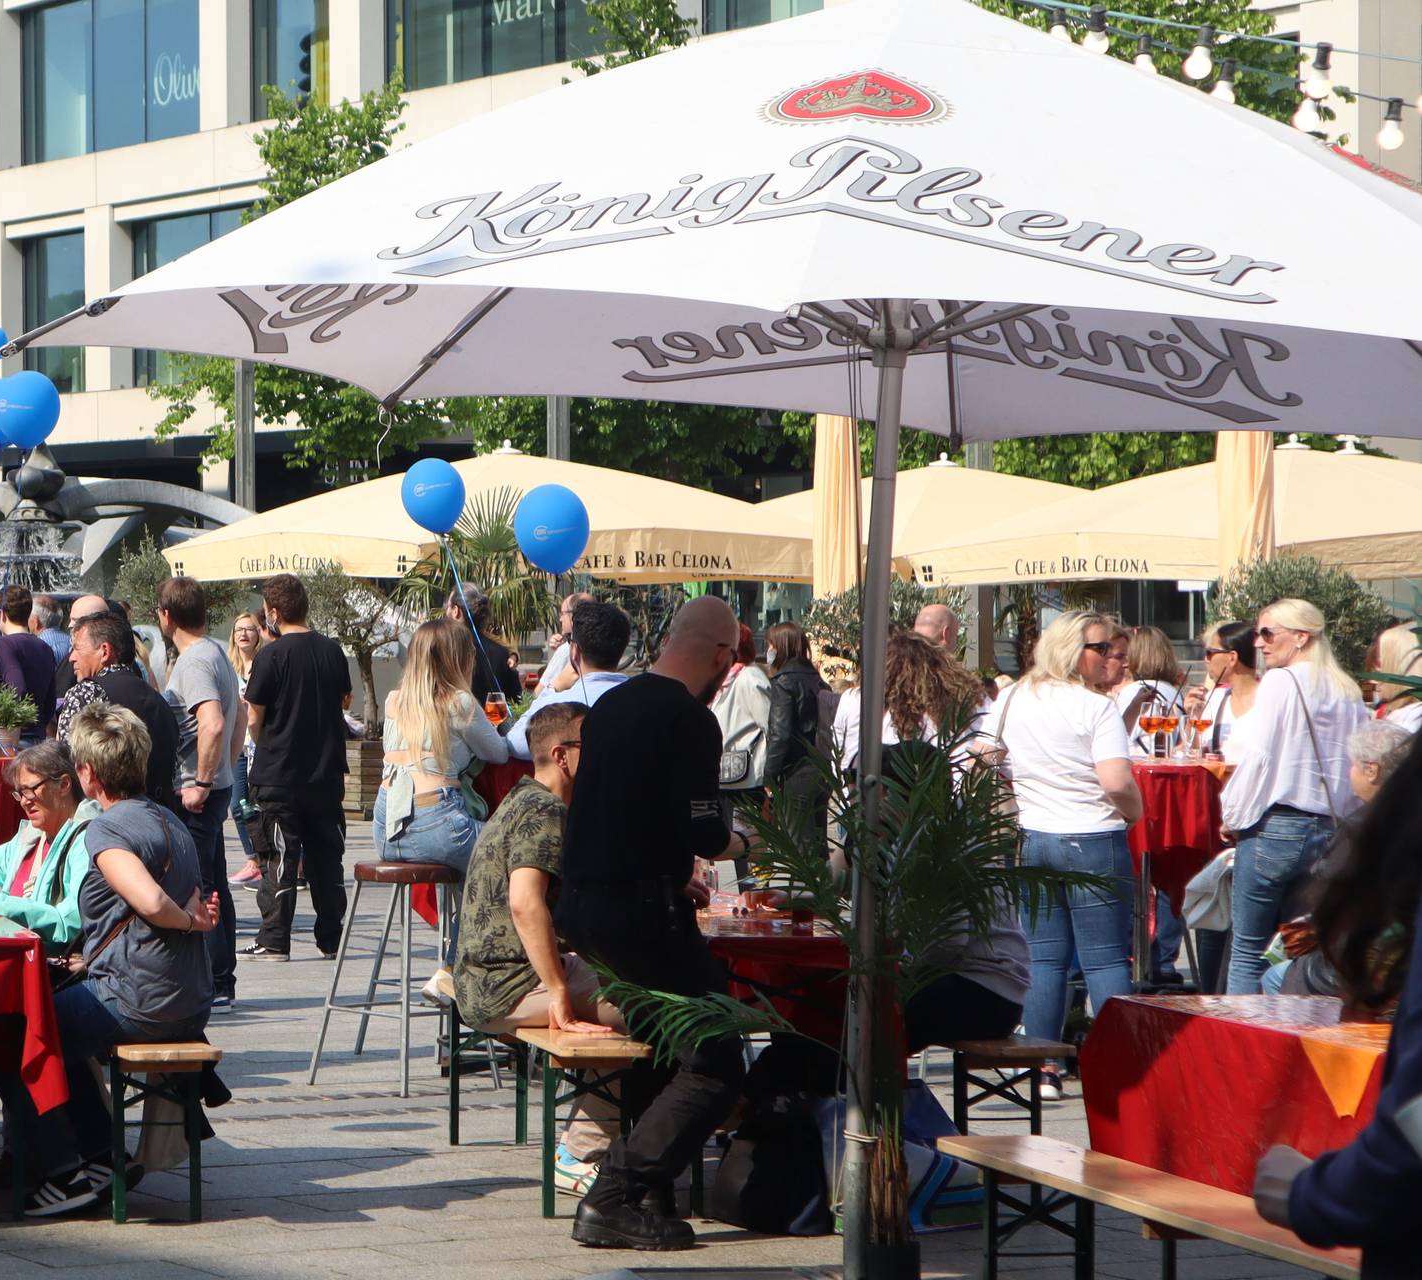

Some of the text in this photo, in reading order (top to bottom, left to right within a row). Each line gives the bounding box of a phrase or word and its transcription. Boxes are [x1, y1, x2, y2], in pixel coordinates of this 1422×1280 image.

[491, 0, 555, 26] Mar
[377, 135, 1286, 287] König Pilsener
[635, 551, 666, 568] BAR
[673, 550, 732, 570] CELONA
[1015, 558, 1046, 576] CAFE
[1062, 556, 1087, 573] BAR
[1095, 554, 1149, 573] CELONA
